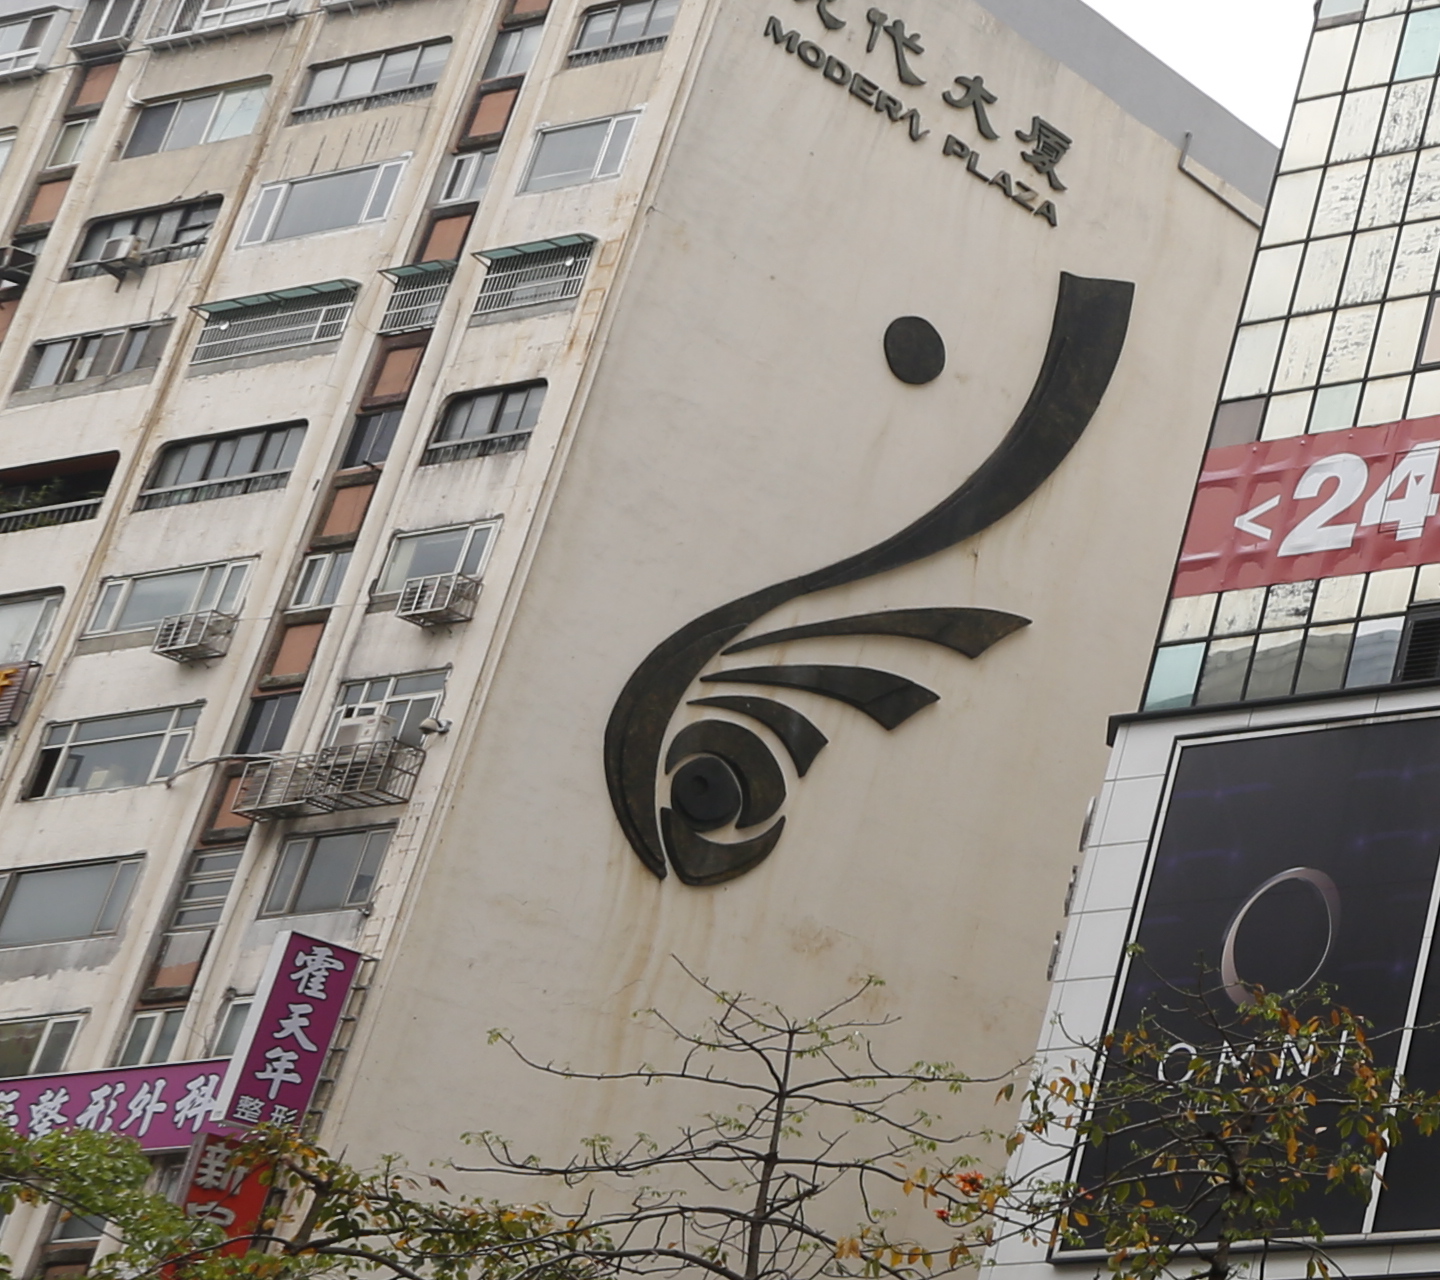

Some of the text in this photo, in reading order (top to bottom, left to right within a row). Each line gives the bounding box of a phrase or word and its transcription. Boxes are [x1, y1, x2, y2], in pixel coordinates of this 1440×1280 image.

[763, 15, 1058, 228] MODERN PLAZA
[254, 945, 344, 1100] 霍天年
